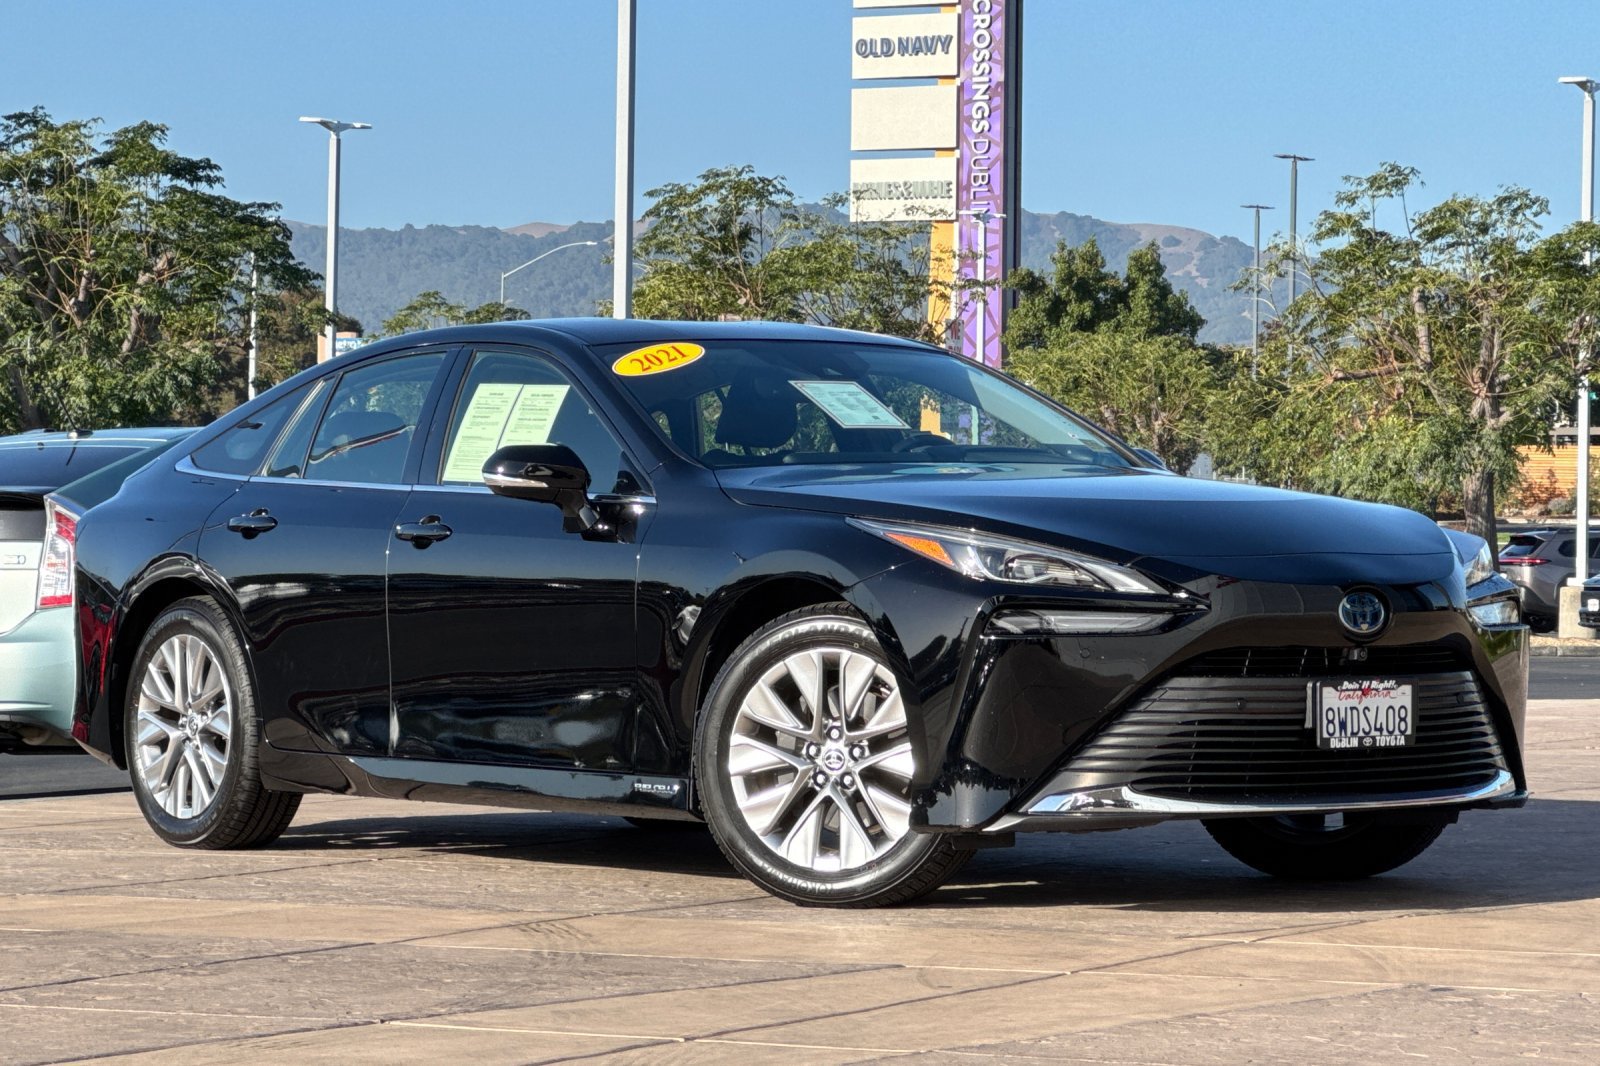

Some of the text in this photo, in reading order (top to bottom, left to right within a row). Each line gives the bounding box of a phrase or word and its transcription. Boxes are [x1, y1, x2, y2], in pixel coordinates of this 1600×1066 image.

[855, 34, 954, 58] OLD NAVY
[971, 0, 992, 134] CROSSINGS
[630, 345, 688, 371] 2021
[1326, 705, 1408, 737] 8WDS408
